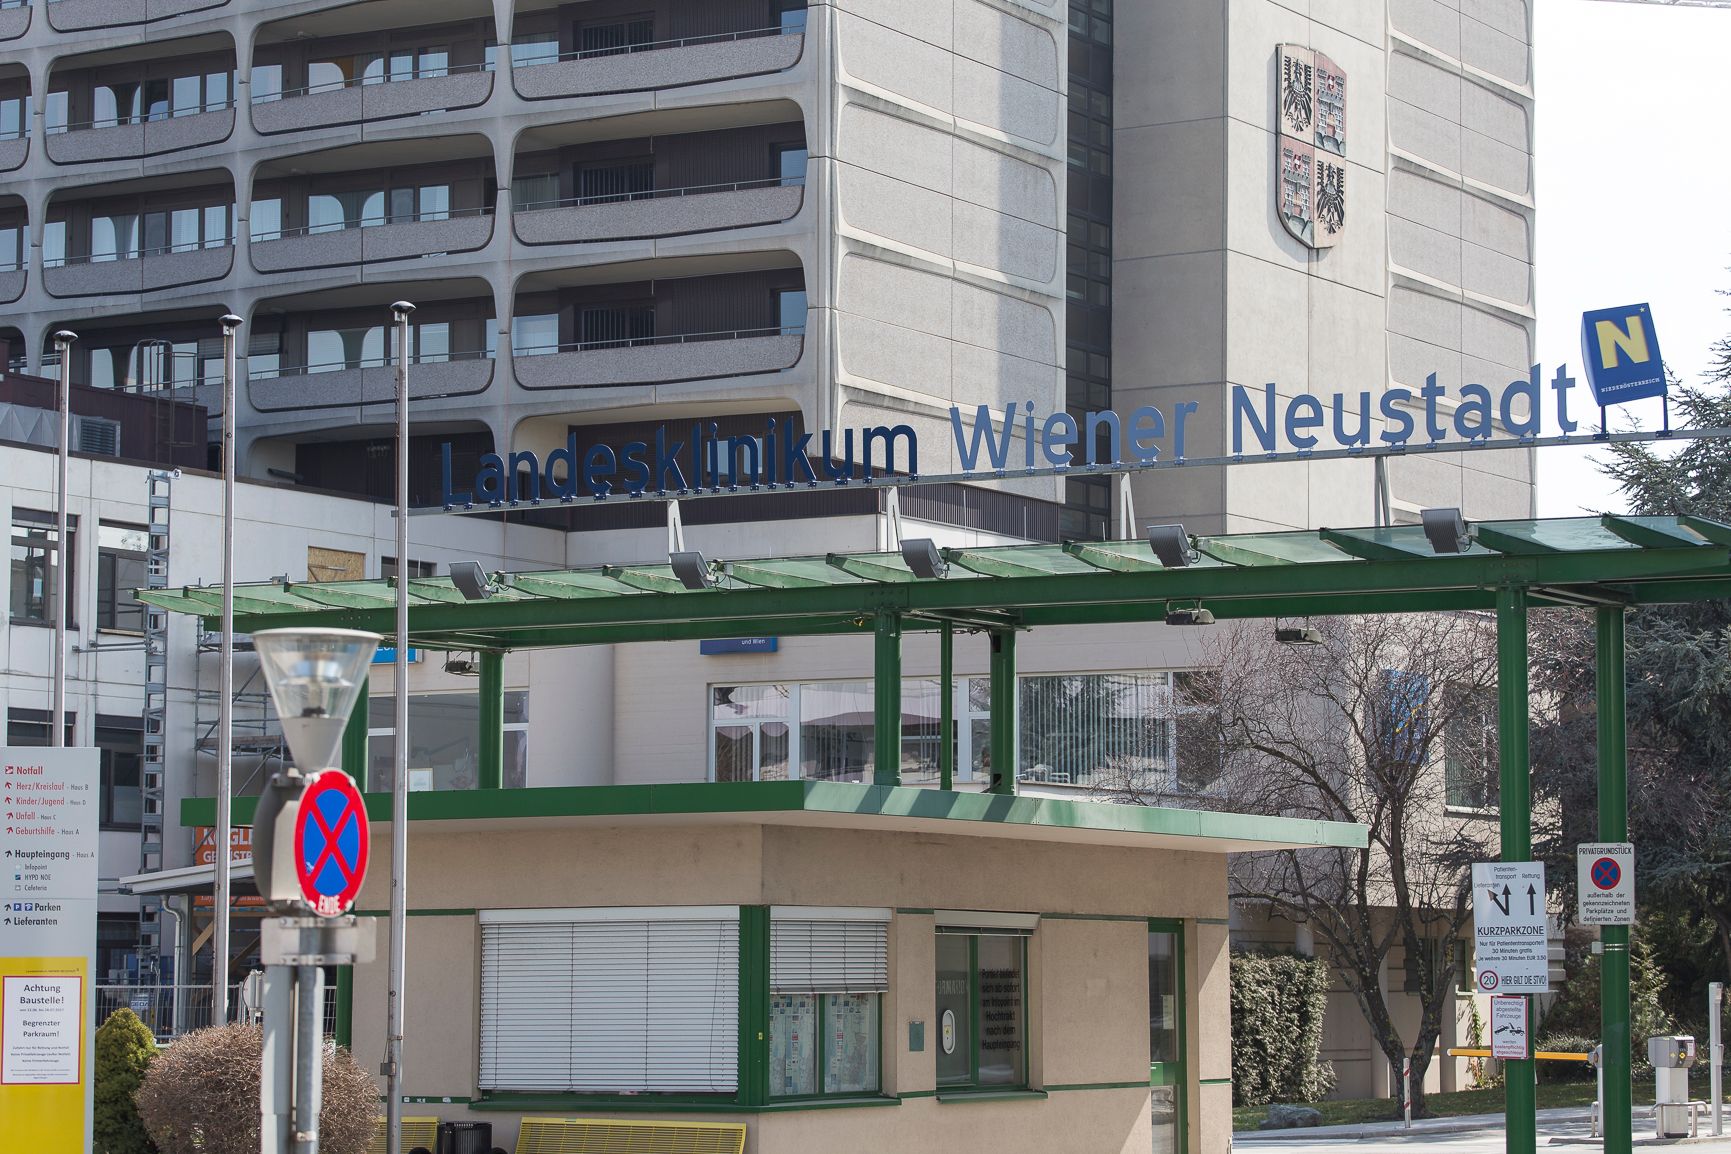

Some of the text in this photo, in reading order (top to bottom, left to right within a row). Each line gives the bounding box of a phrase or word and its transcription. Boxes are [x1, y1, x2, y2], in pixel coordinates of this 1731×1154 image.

[442, 363, 1578, 505] Landesklinikum Wiener Neustadt
[16, 766, 43, 775] Notfall
[16, 781, 65, 791] Herz/Kreislauf
[16, 797, 65, 806] Kinder/Jugend
[16, 812, 36, 820] Unfall
[16, 826, 55, 835] Geburtshilfe
[14, 850, 70, 860] Haupteingang
[1578, 846, 1632, 855] PRIVATGRUNDSTÜCK
[34, 902, 61, 911] Parken
[318, 895, 341, 914] ENDE
[14, 916, 58, 926] Lieferanten
[1477, 926, 1544, 936] KURZPARKZONE
[1484, 975, 1496, 986] 20
[1501, 976, 1512, 984] HIER
[1514, 976, 1524, 984] GILT
[1524, 976, 1532, 984] DIE
[24, 984, 61, 993] Achtung
[20, 996, 64, 1004] Baustelle!
[986, 1025, 1002, 1036] nach
